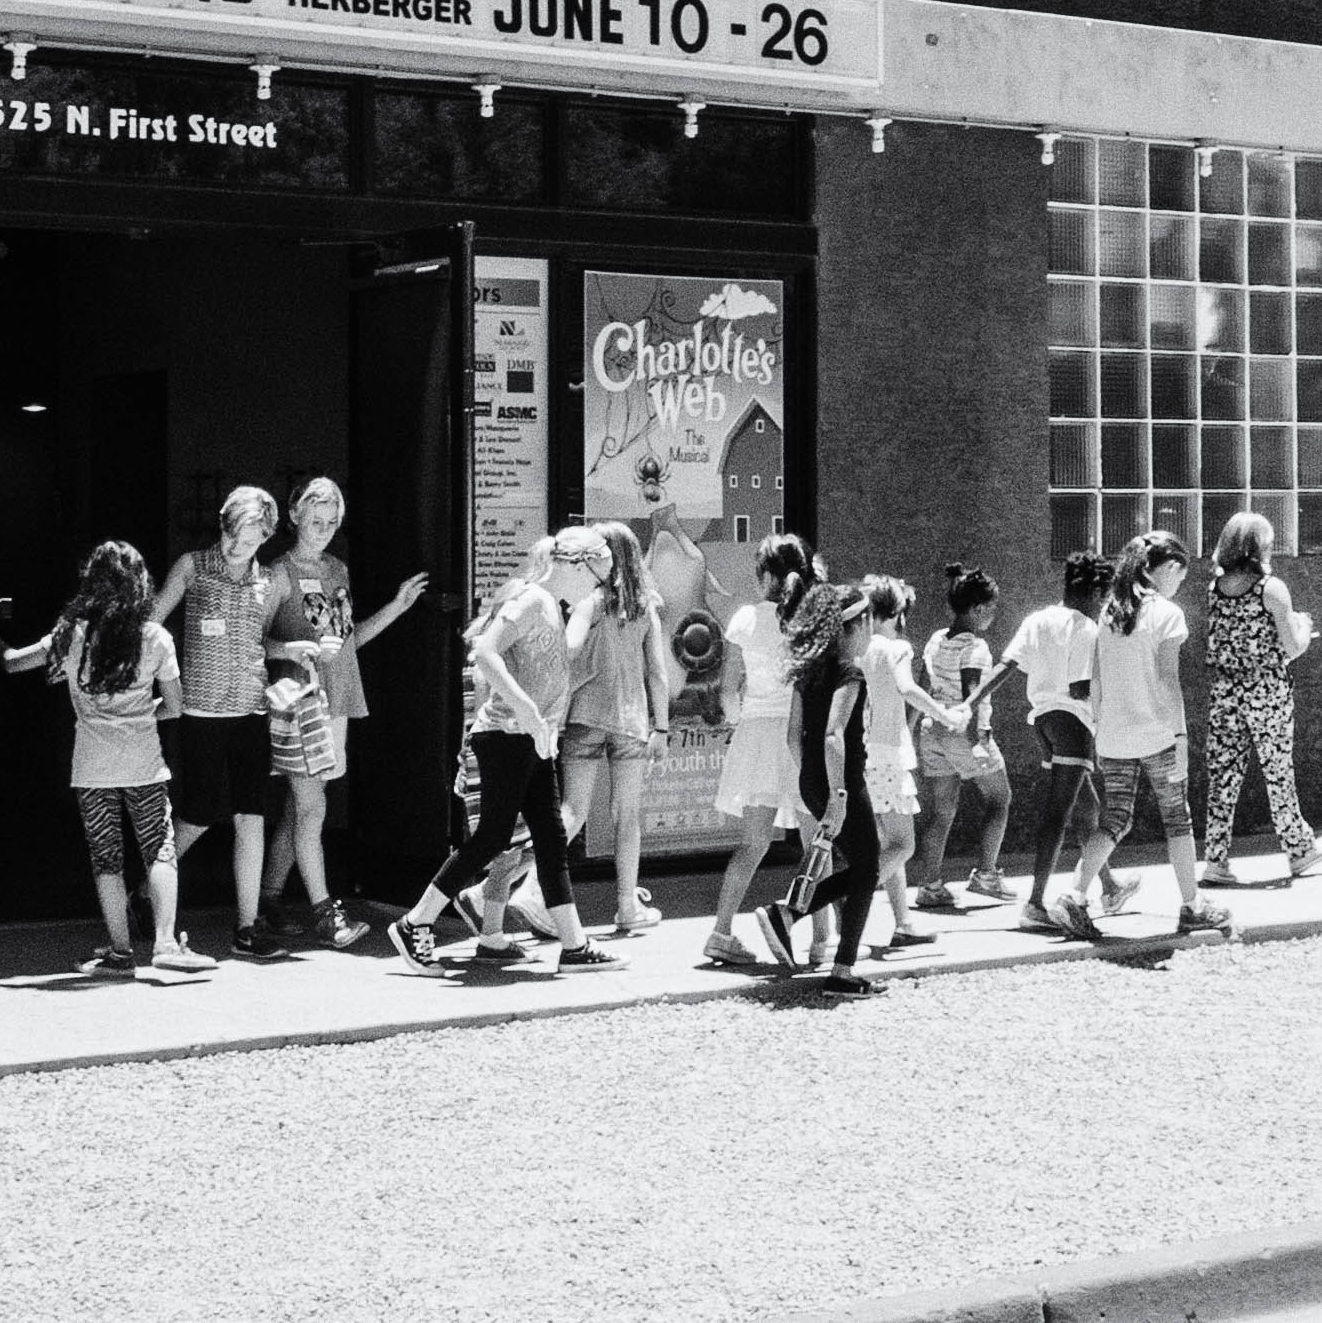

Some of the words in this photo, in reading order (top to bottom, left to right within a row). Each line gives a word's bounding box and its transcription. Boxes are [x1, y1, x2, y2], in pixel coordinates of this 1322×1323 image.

[761, 2, 828, 65] 26
[66, 105, 101, 136] N.
[109, 108, 178, 142] First
[188, 114, 277, 149] Street
[591, 319, 775, 392] Charlotte's
[649, 374, 727, 430] Web
[668, 446, 710, 463] Musical
[684, 429, 705, 445] The
